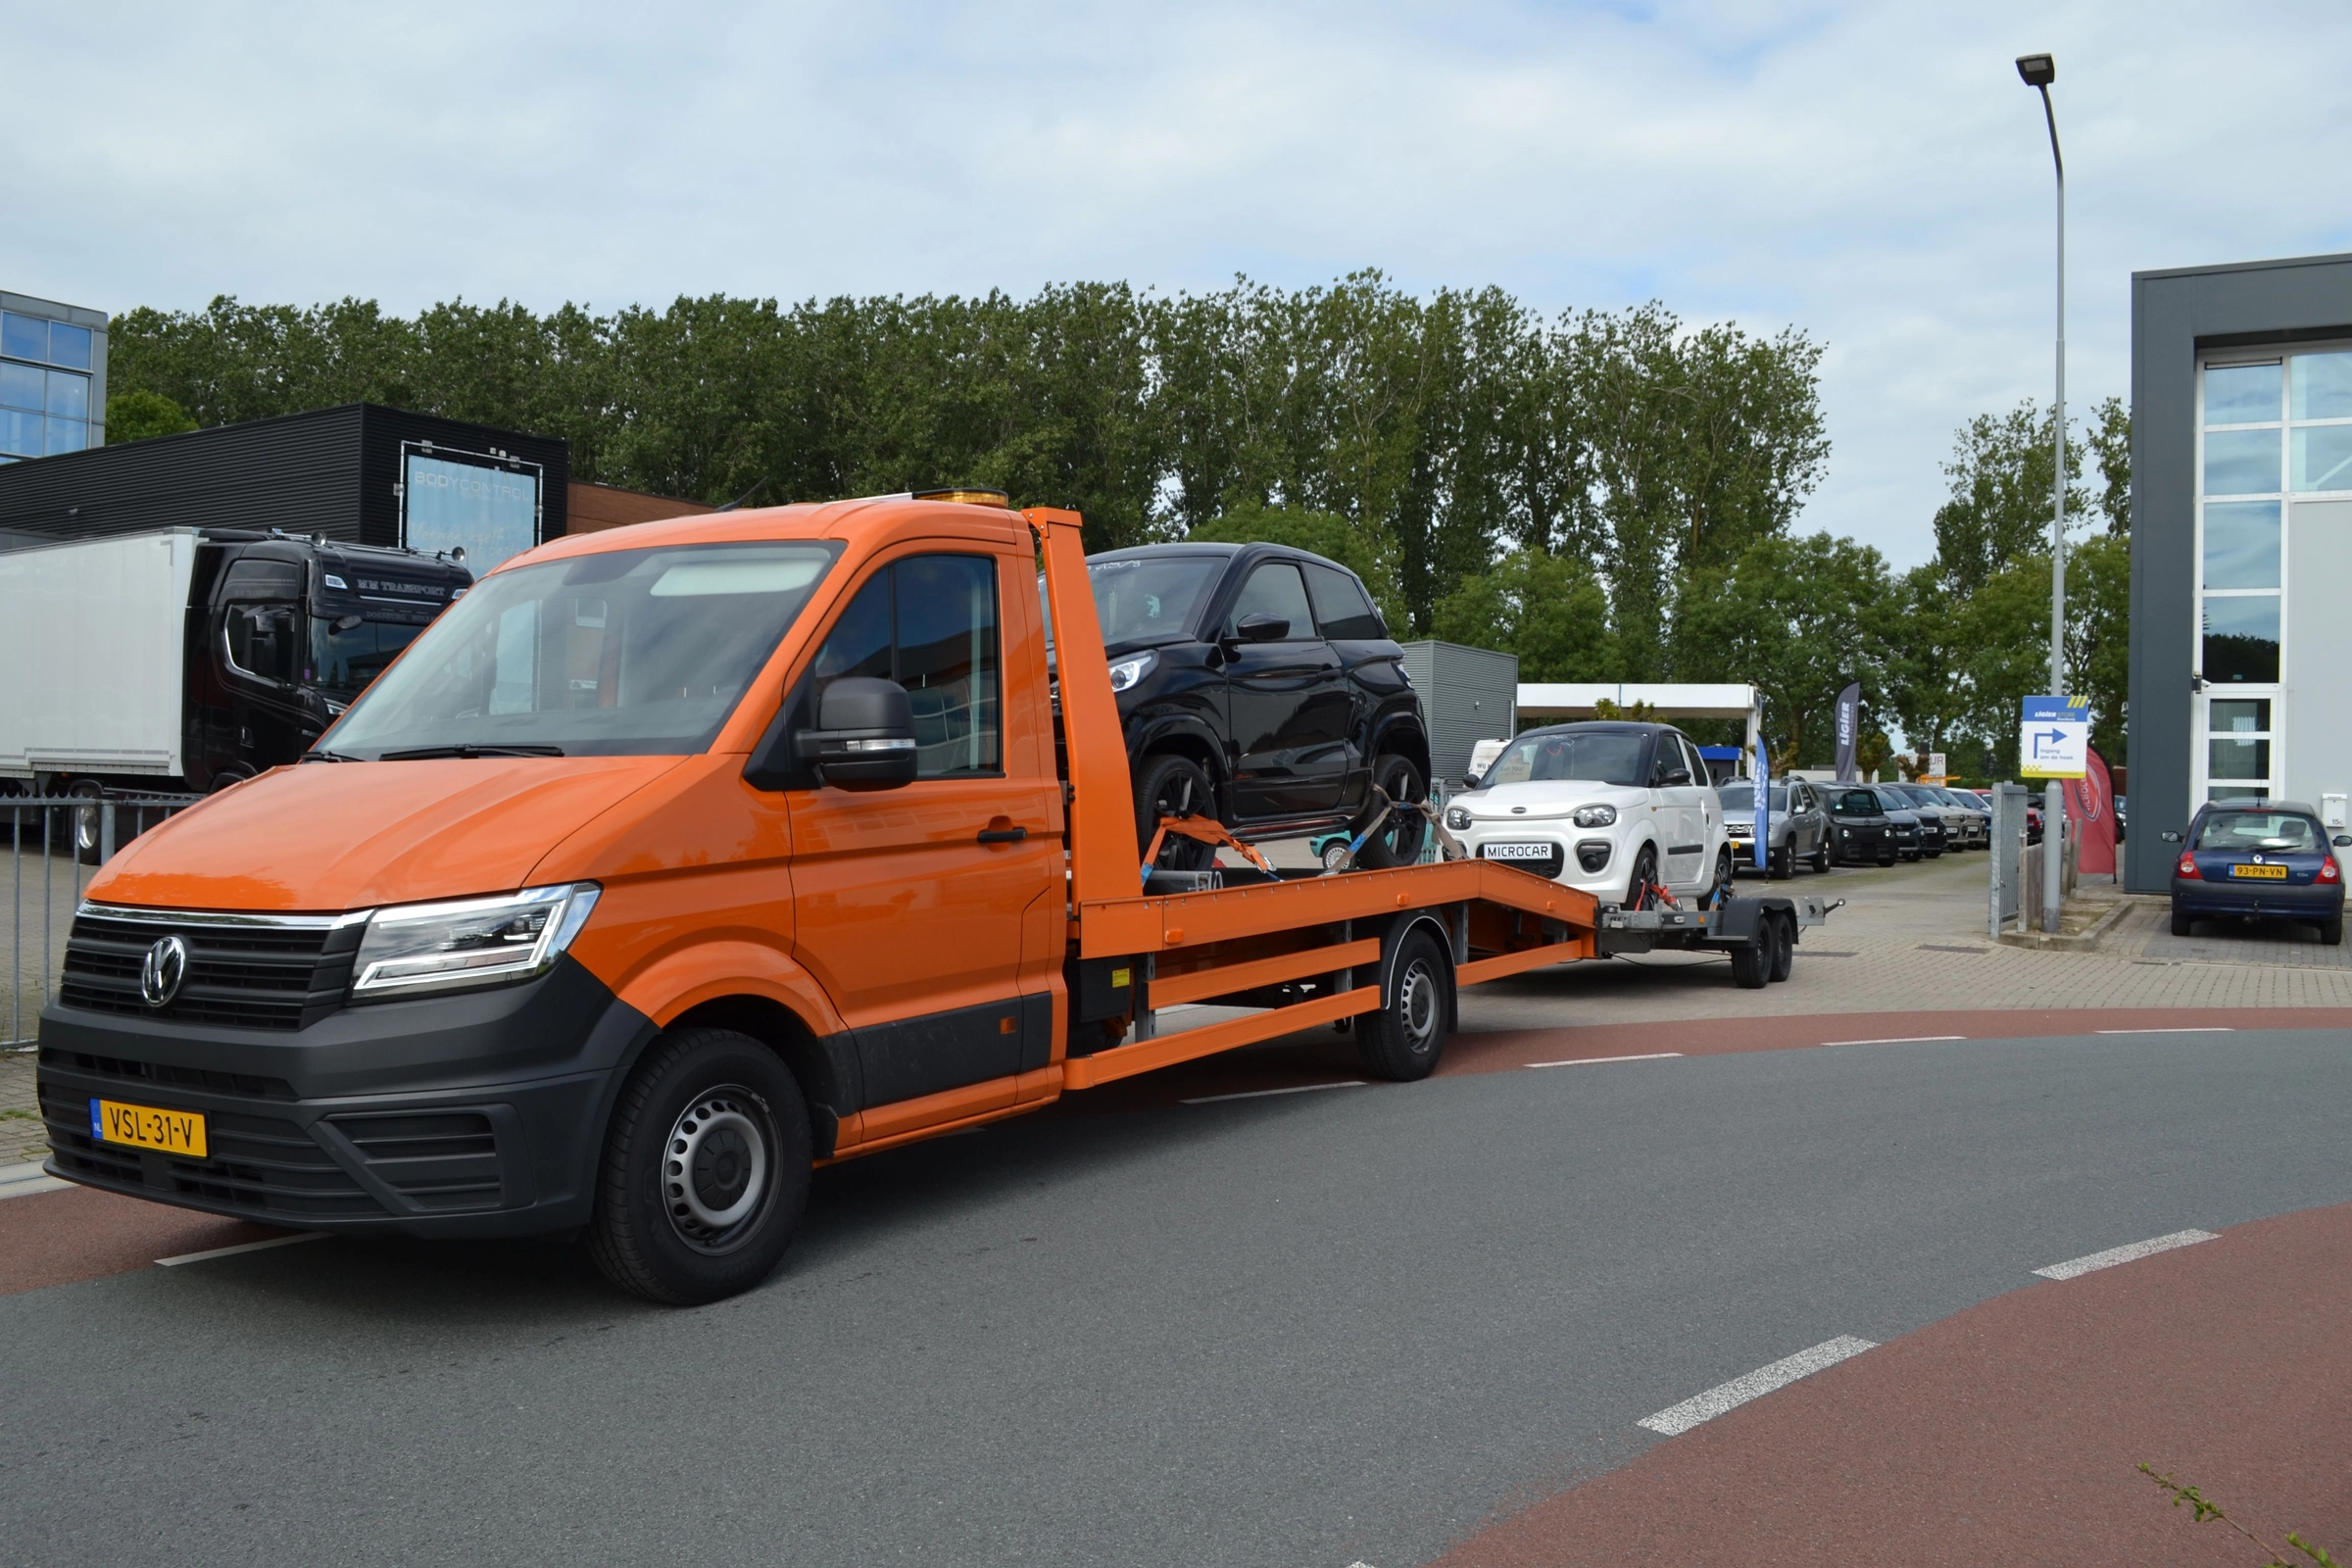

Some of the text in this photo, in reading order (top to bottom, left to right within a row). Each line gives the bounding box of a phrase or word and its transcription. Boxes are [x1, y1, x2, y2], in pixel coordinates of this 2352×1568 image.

[415, 471, 529, 501] BODYCONTROL
[380, 581, 446, 596] TRANSPORT
[366, 611, 438, 622] DOESBURG HOLLA
[1839, 702, 1850, 746] LIGIER
[1488, 846, 1548, 858] MICROCAR
[2236, 866, 2282, 876] 93-PN-VN
[93, 1122, 103, 1132] NL
[109, 1106, 192, 1149] VSL-31-V
